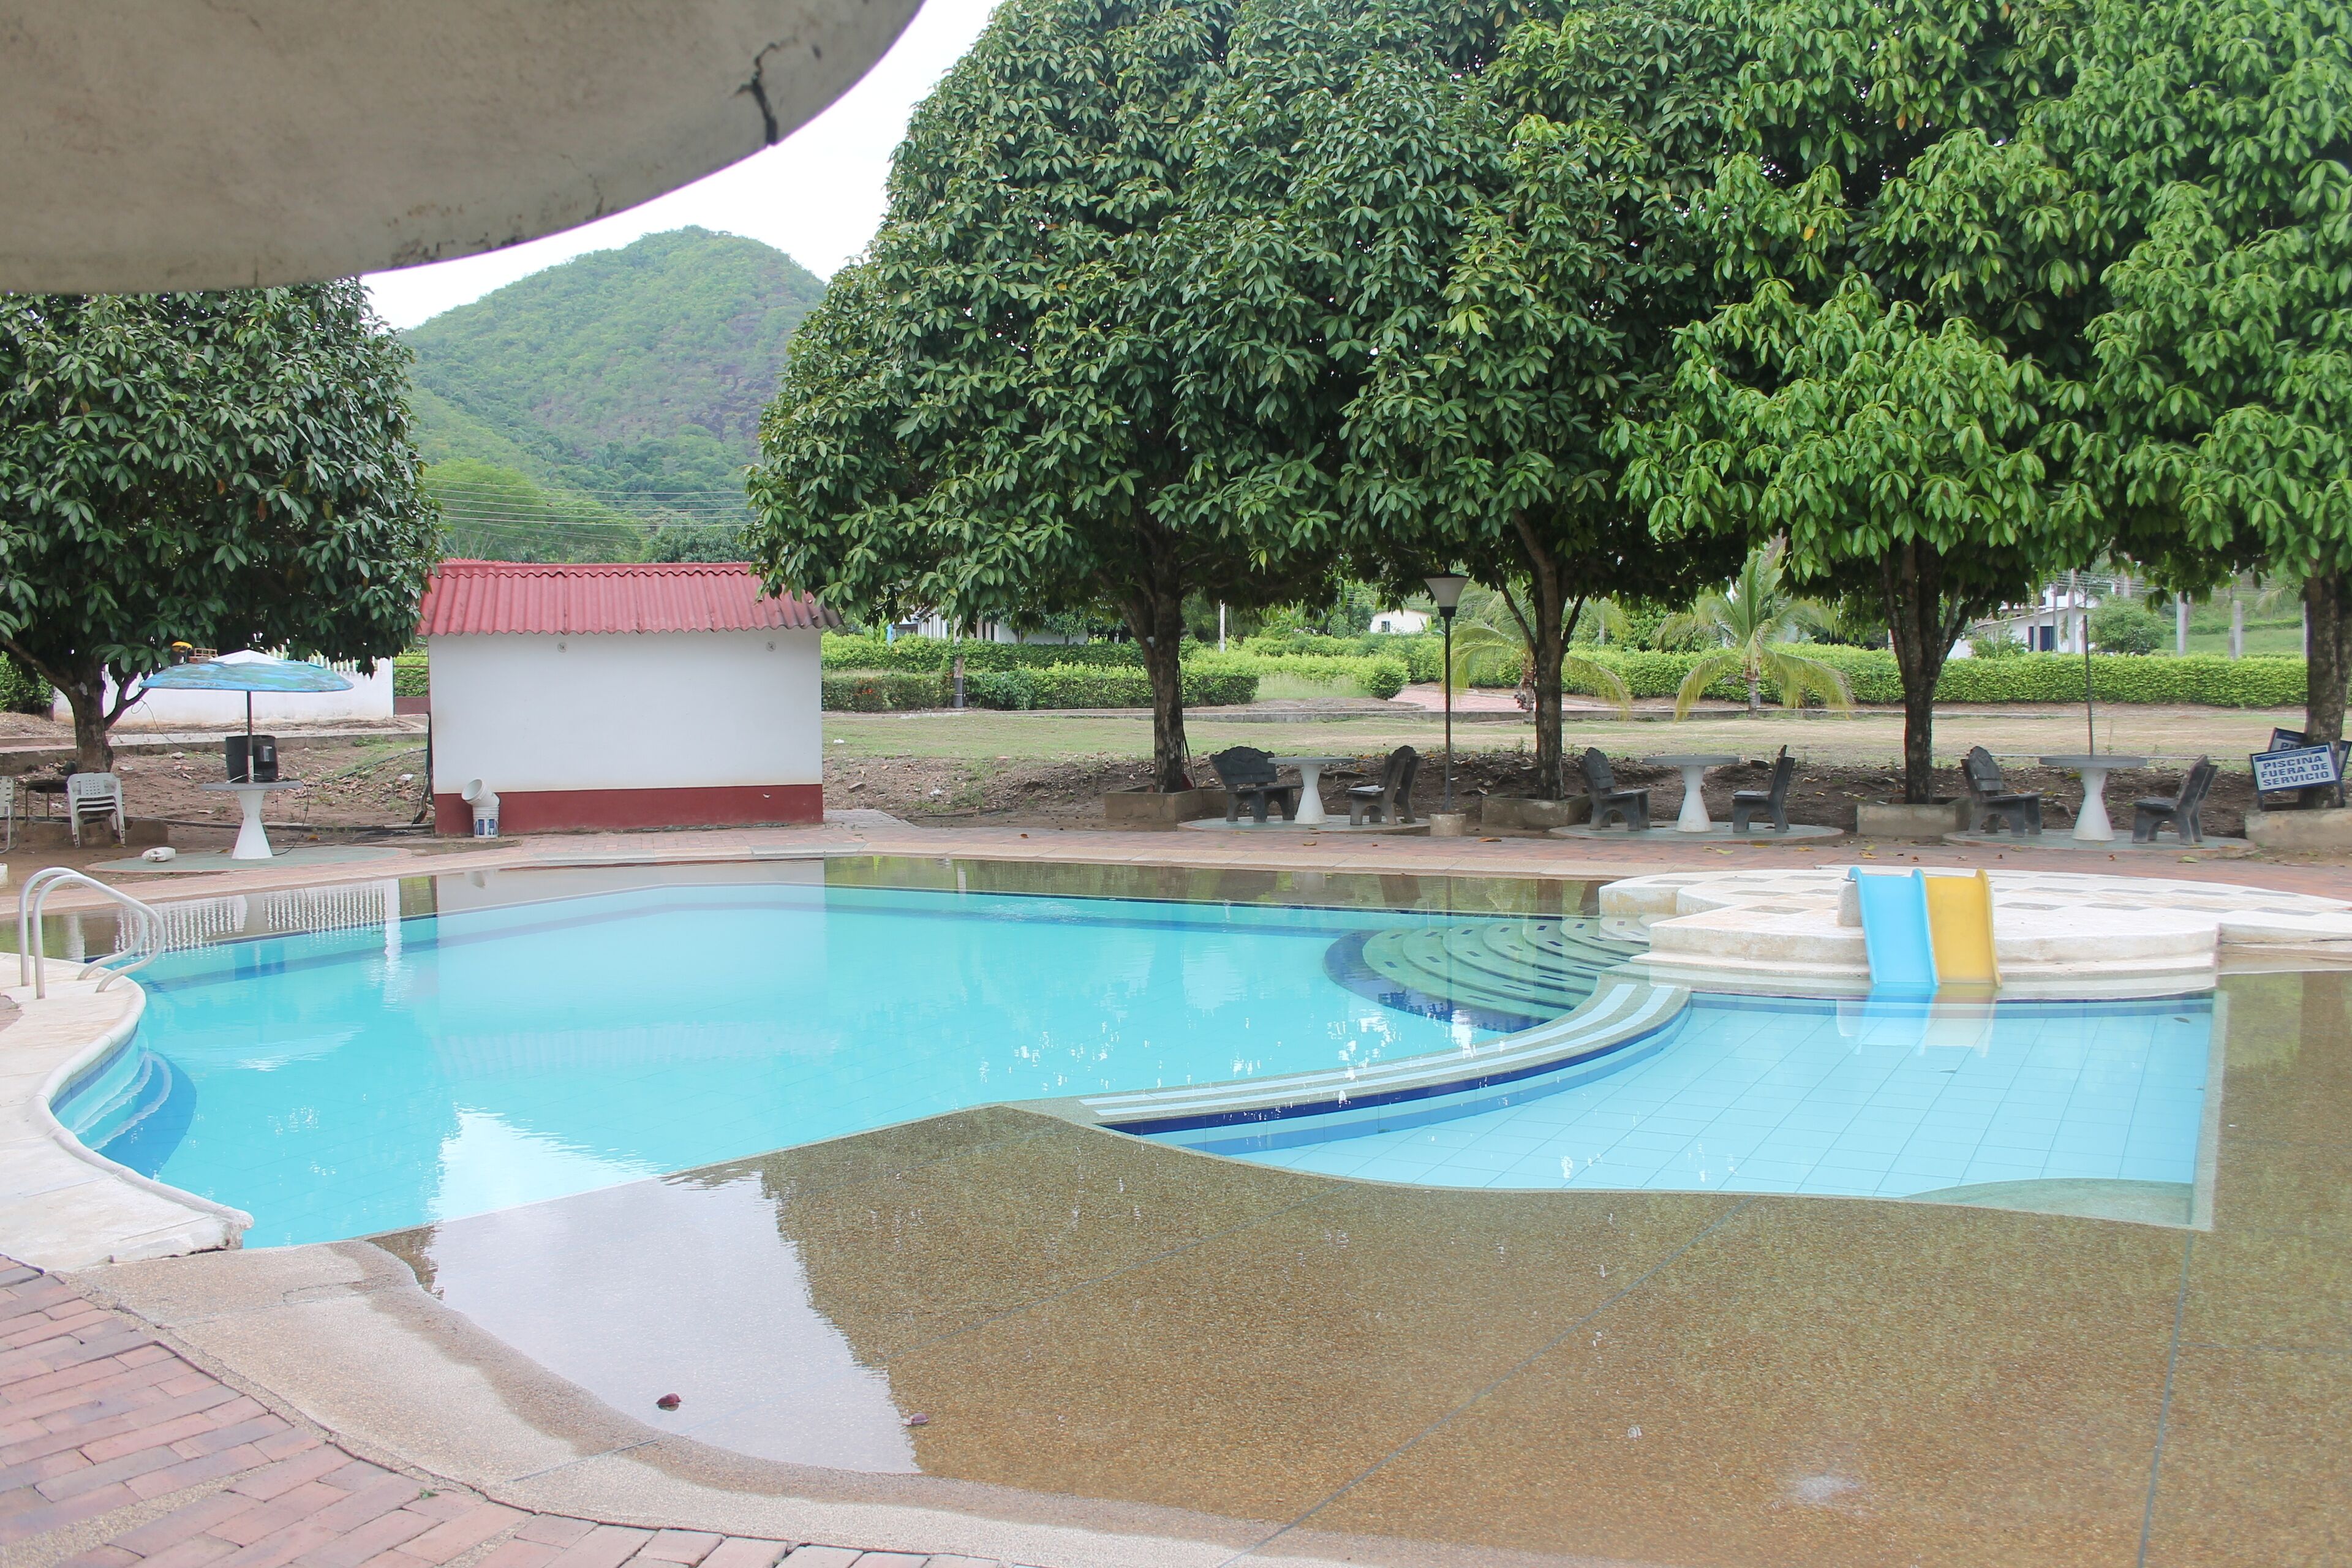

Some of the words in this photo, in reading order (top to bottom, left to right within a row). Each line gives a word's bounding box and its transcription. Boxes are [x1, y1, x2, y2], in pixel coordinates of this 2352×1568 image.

[2263, 755, 2323, 769] PISCINA
[2260, 766, 2305, 778] FUERA
[2310, 763, 2328, 771] DE
[2263, 771, 2329, 786] SERVICIO
